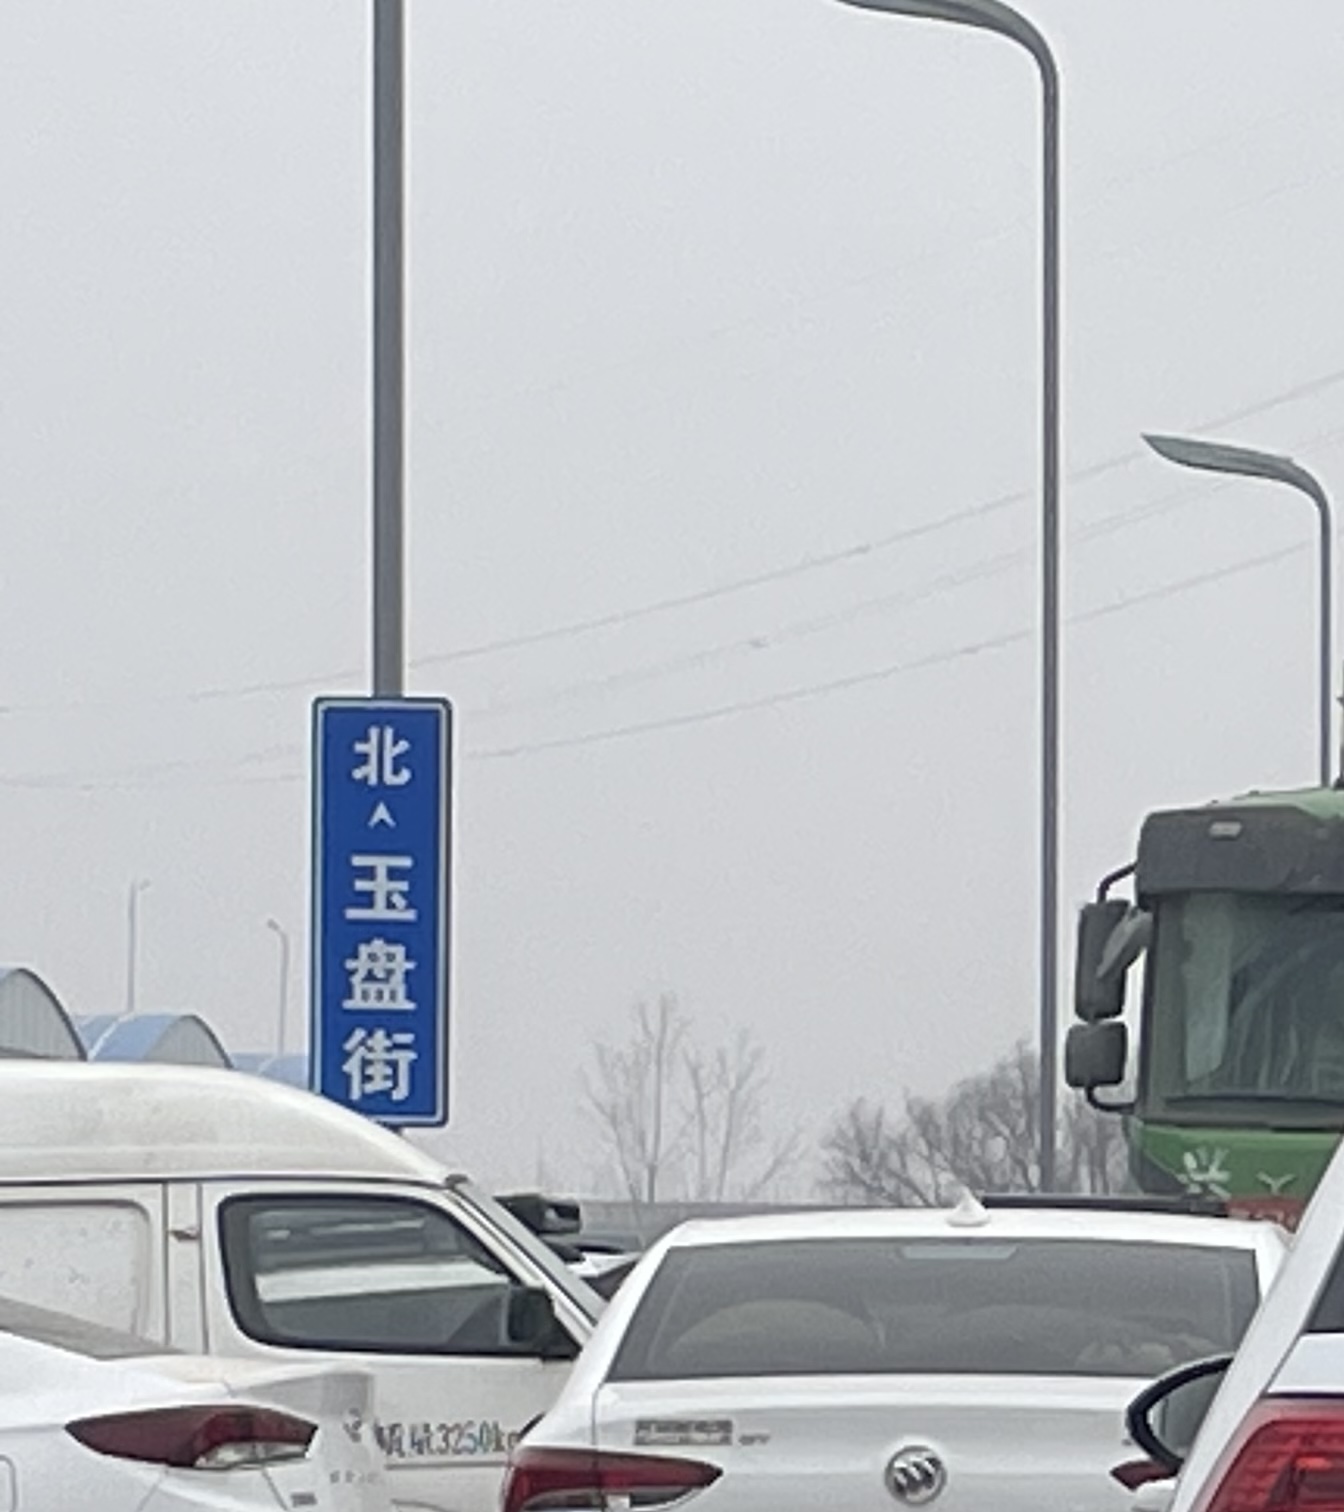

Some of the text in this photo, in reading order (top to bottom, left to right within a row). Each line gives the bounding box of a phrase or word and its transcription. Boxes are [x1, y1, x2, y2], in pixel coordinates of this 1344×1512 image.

[351, 726, 411, 786] 北
[342, 854, 417, 1101] 玉盘街
